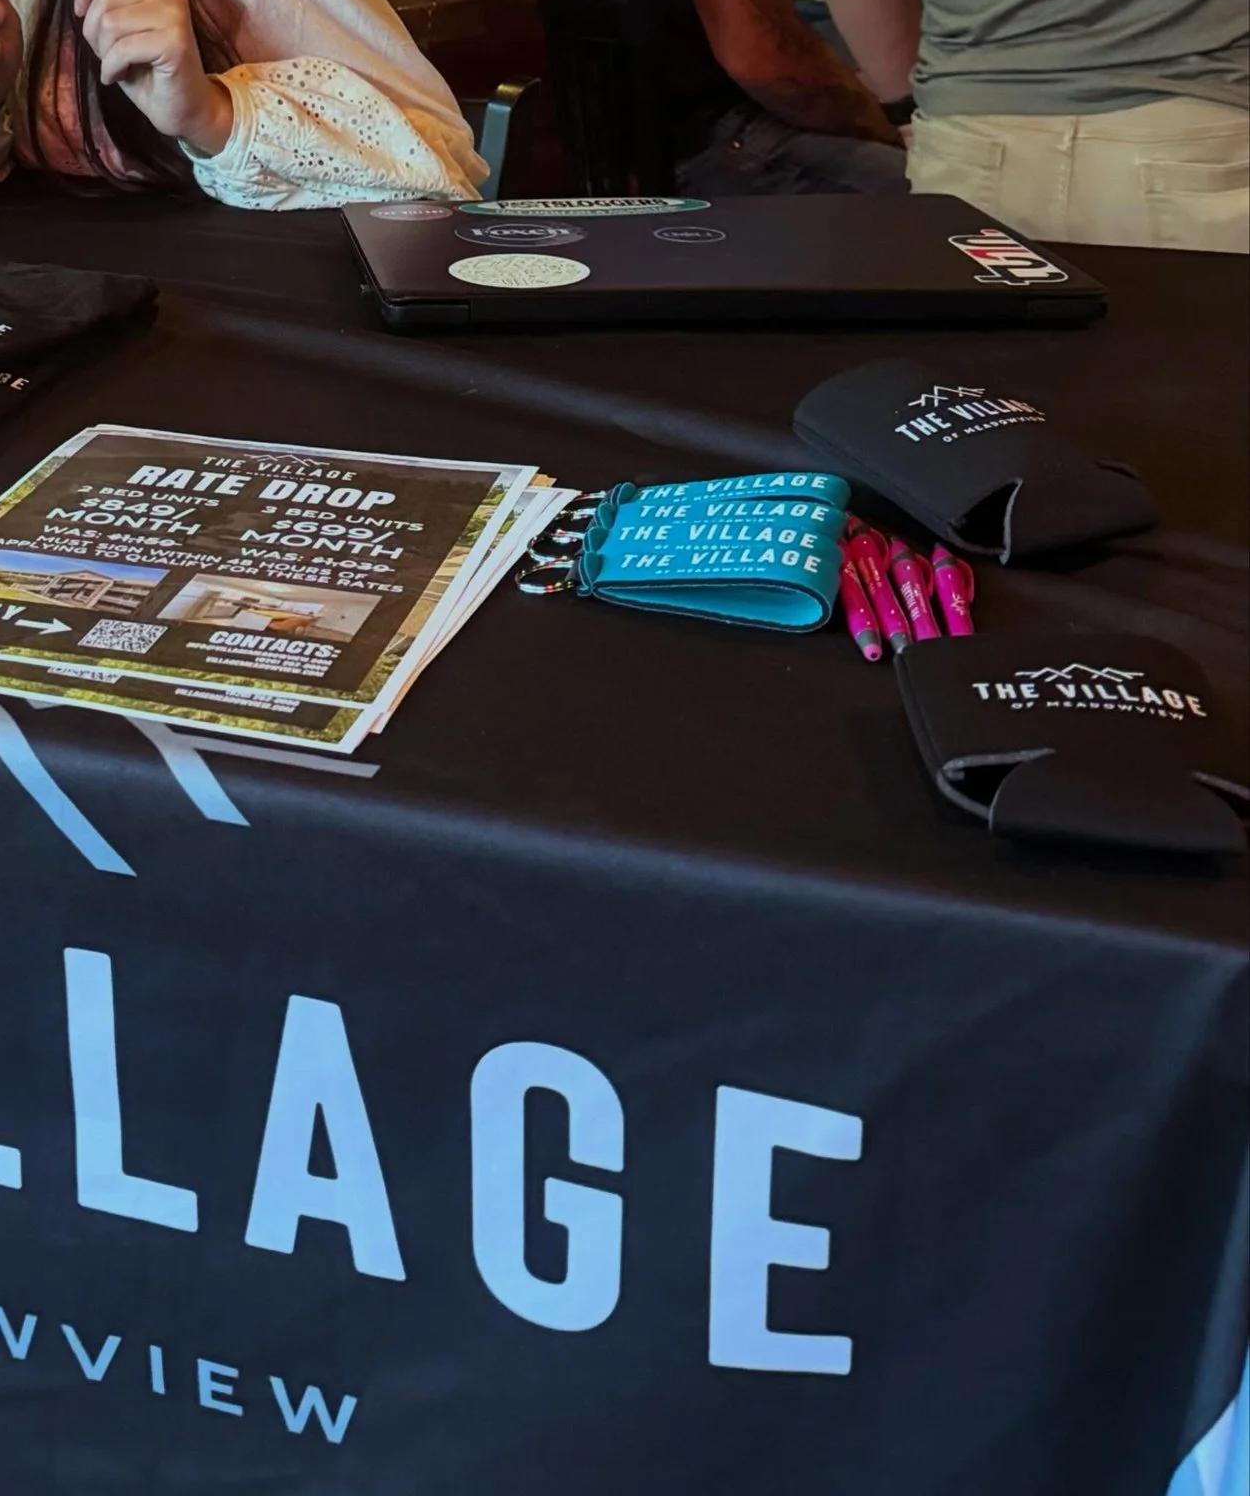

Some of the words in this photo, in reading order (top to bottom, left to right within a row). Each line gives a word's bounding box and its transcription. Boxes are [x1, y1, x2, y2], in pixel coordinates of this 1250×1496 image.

[895, 412, 951, 442] THE
[943, 432, 958, 443] OF
[202, 456, 247, 468] THE
[258, 461, 357, 481] VILLAGE
[77, 485, 93, 493] 2
[99, 487, 144, 498] BED
[151, 491, 220, 507] UNITS
[126, 465, 252, 496] RATE
[258, 479, 396, 511] DROP
[639, 484, 690, 501] THE
[706, 475, 829, 492] VILLAGE
[46, 507, 201, 536] MONTH
[80, 498, 197, 521] $849/
[261, 506, 278, 514] 3
[285, 508, 336, 520] BED
[345, 515, 425, 532] UNITS
[640, 505, 692, 517] THE
[706, 503, 830, 521] VILLAGE
[44, 525, 103, 538] WAS:
[272, 519, 395, 543] $699/
[619, 525, 672, 540] THE
[689, 524, 818, 549] VILLAGE
[239, 529, 404, 560] MONTH
[240, 548, 304, 562] WAS:
[36, 535, 93, 547] MUST
[96, 542, 144, 554] SIGN
[149, 548, 221, 564] WITHIN
[227, 558, 254, 567] 48
[259, 561, 332, 577] HOURS
[338, 571, 369, 581] OF
[620, 554, 675, 568] THE
[691, 548, 821, 573] VILLAGE
[95, 549, 120, 559] TO
[125, 553, 215, 570] QUALIFY
[216, 564, 259, 575] FOR
[266, 569, 332, 584] THESE
[336, 577, 404, 594] RATES
[209, 630, 342, 659] CONTACTS:
[972, 683, 1039, 700] THE
[1055, 683, 1207, 717] VILLAGE
[1047, 701, 1184, 720] MEADOWVIEW
